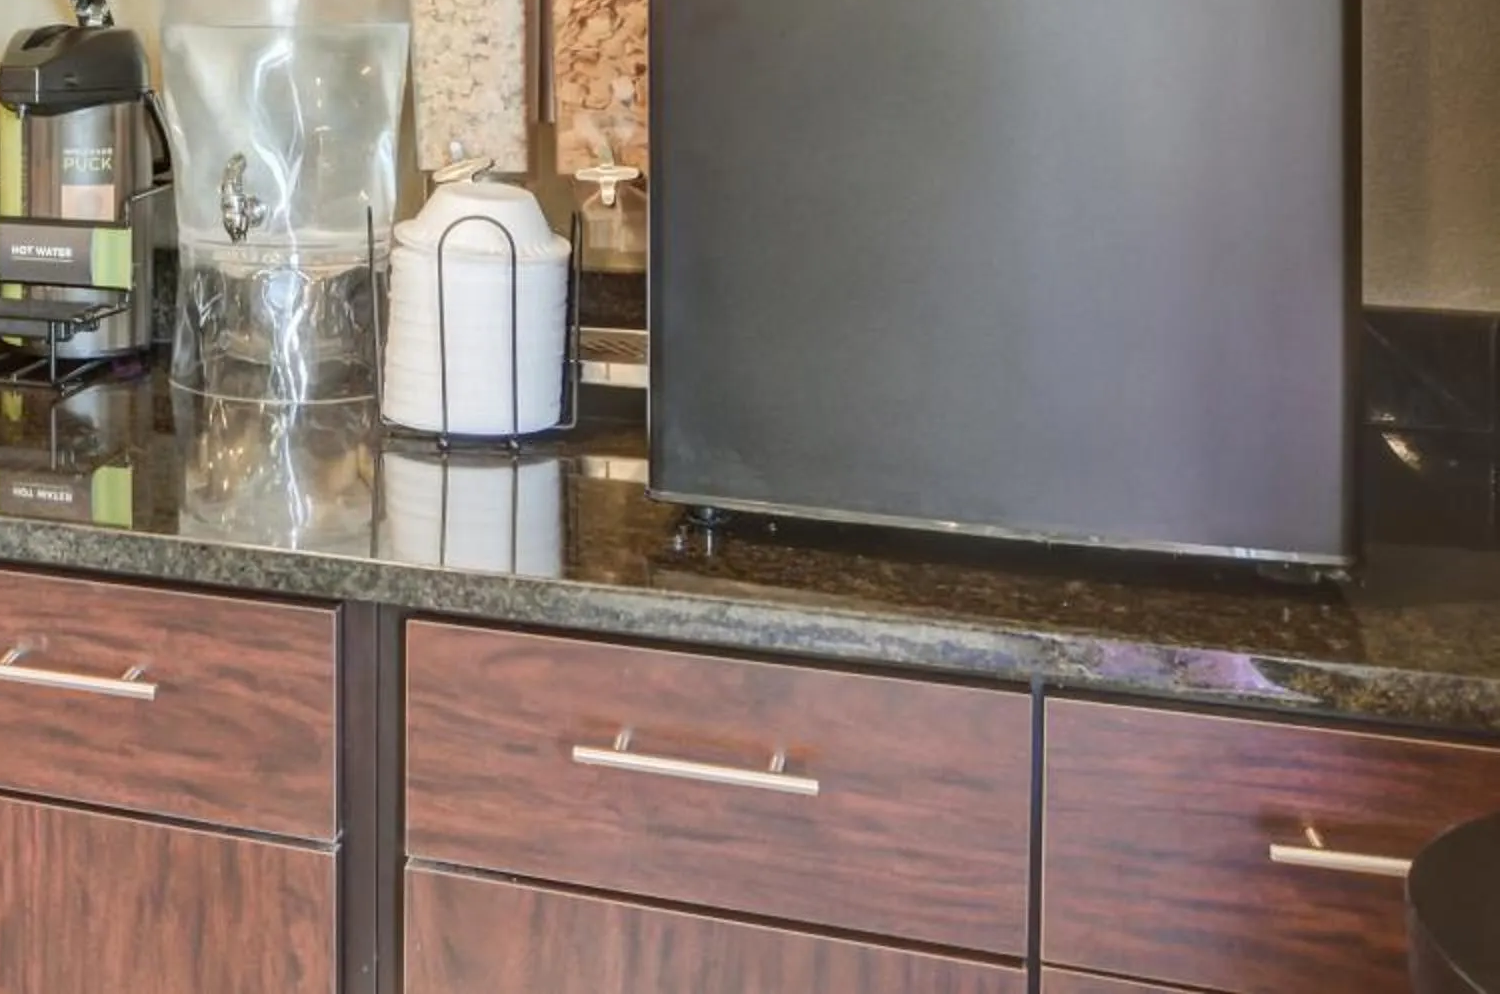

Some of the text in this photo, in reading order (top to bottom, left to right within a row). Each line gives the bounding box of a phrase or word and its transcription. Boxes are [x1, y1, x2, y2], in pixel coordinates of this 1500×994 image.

[63, 157, 112, 172] PUCK
[11, 245, 73, 258] HOT WATER
